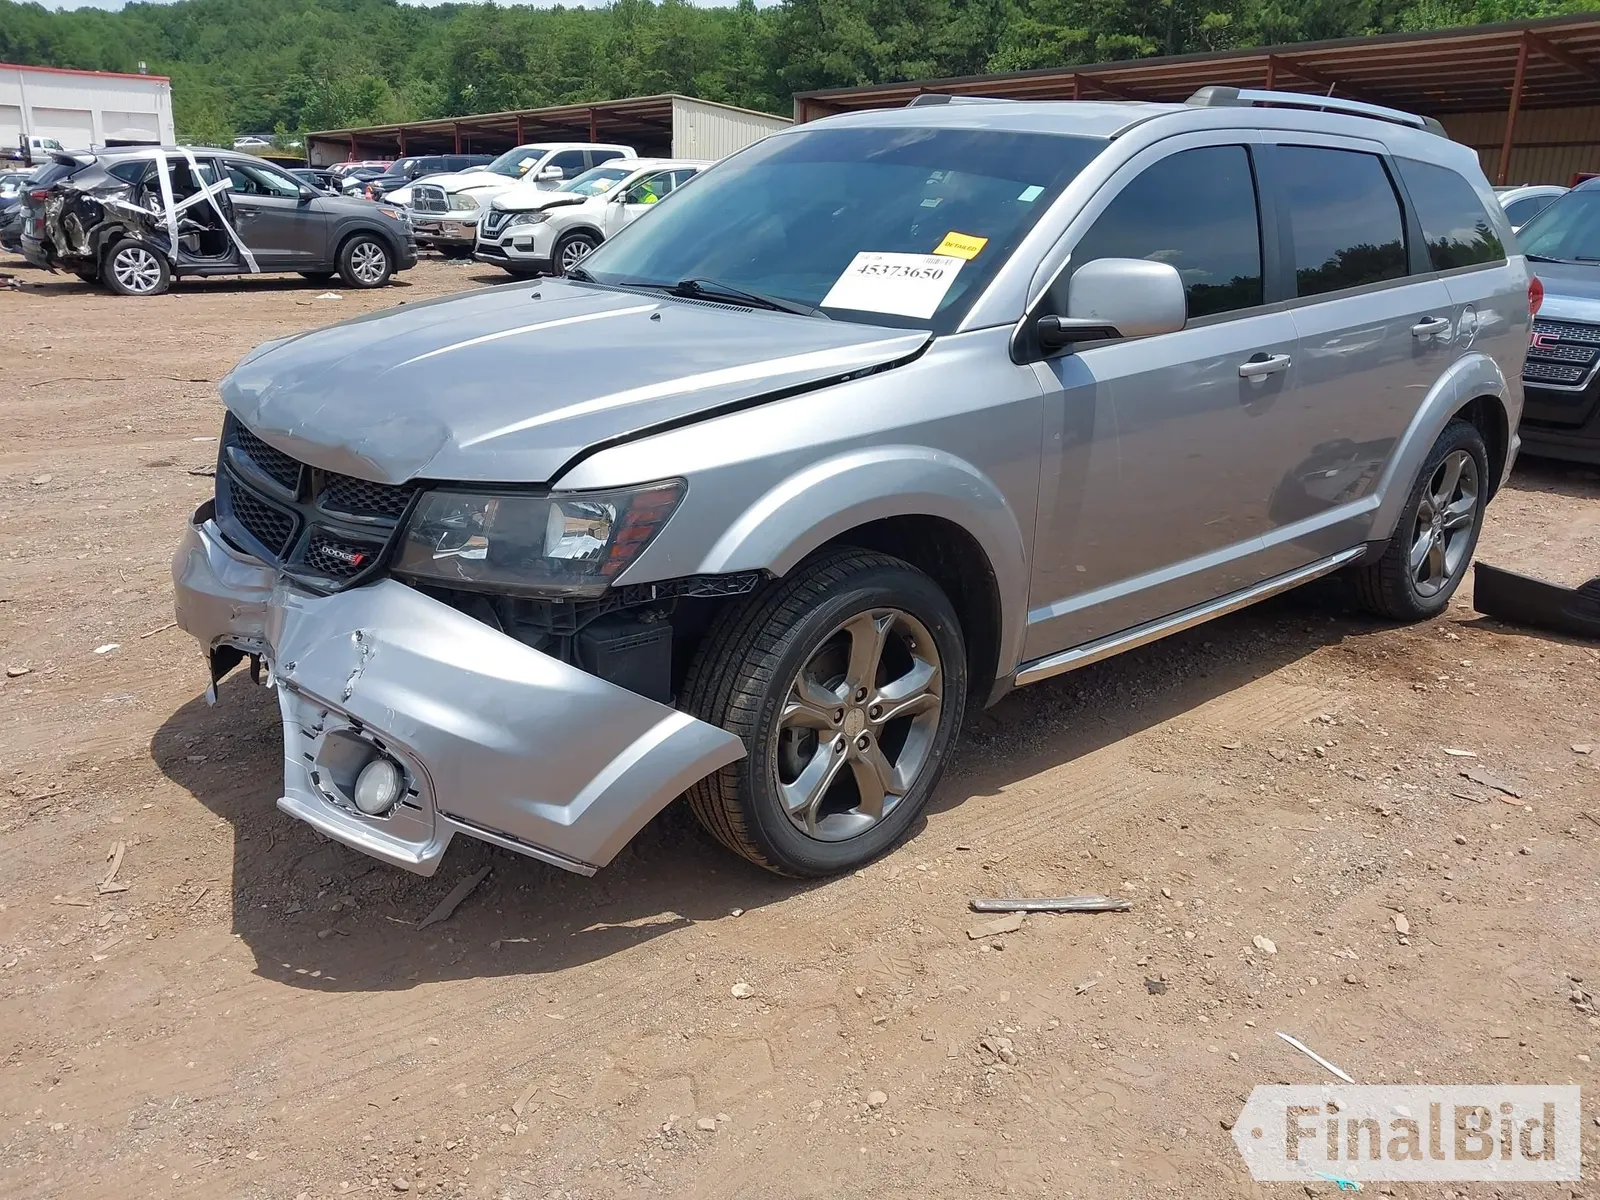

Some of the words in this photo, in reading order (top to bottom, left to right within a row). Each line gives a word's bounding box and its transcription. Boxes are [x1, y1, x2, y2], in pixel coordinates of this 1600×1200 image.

[944, 240, 977, 252] DETAILED
[857, 264, 944, 280] 45373650
[322, 546, 356, 562] DODGE
